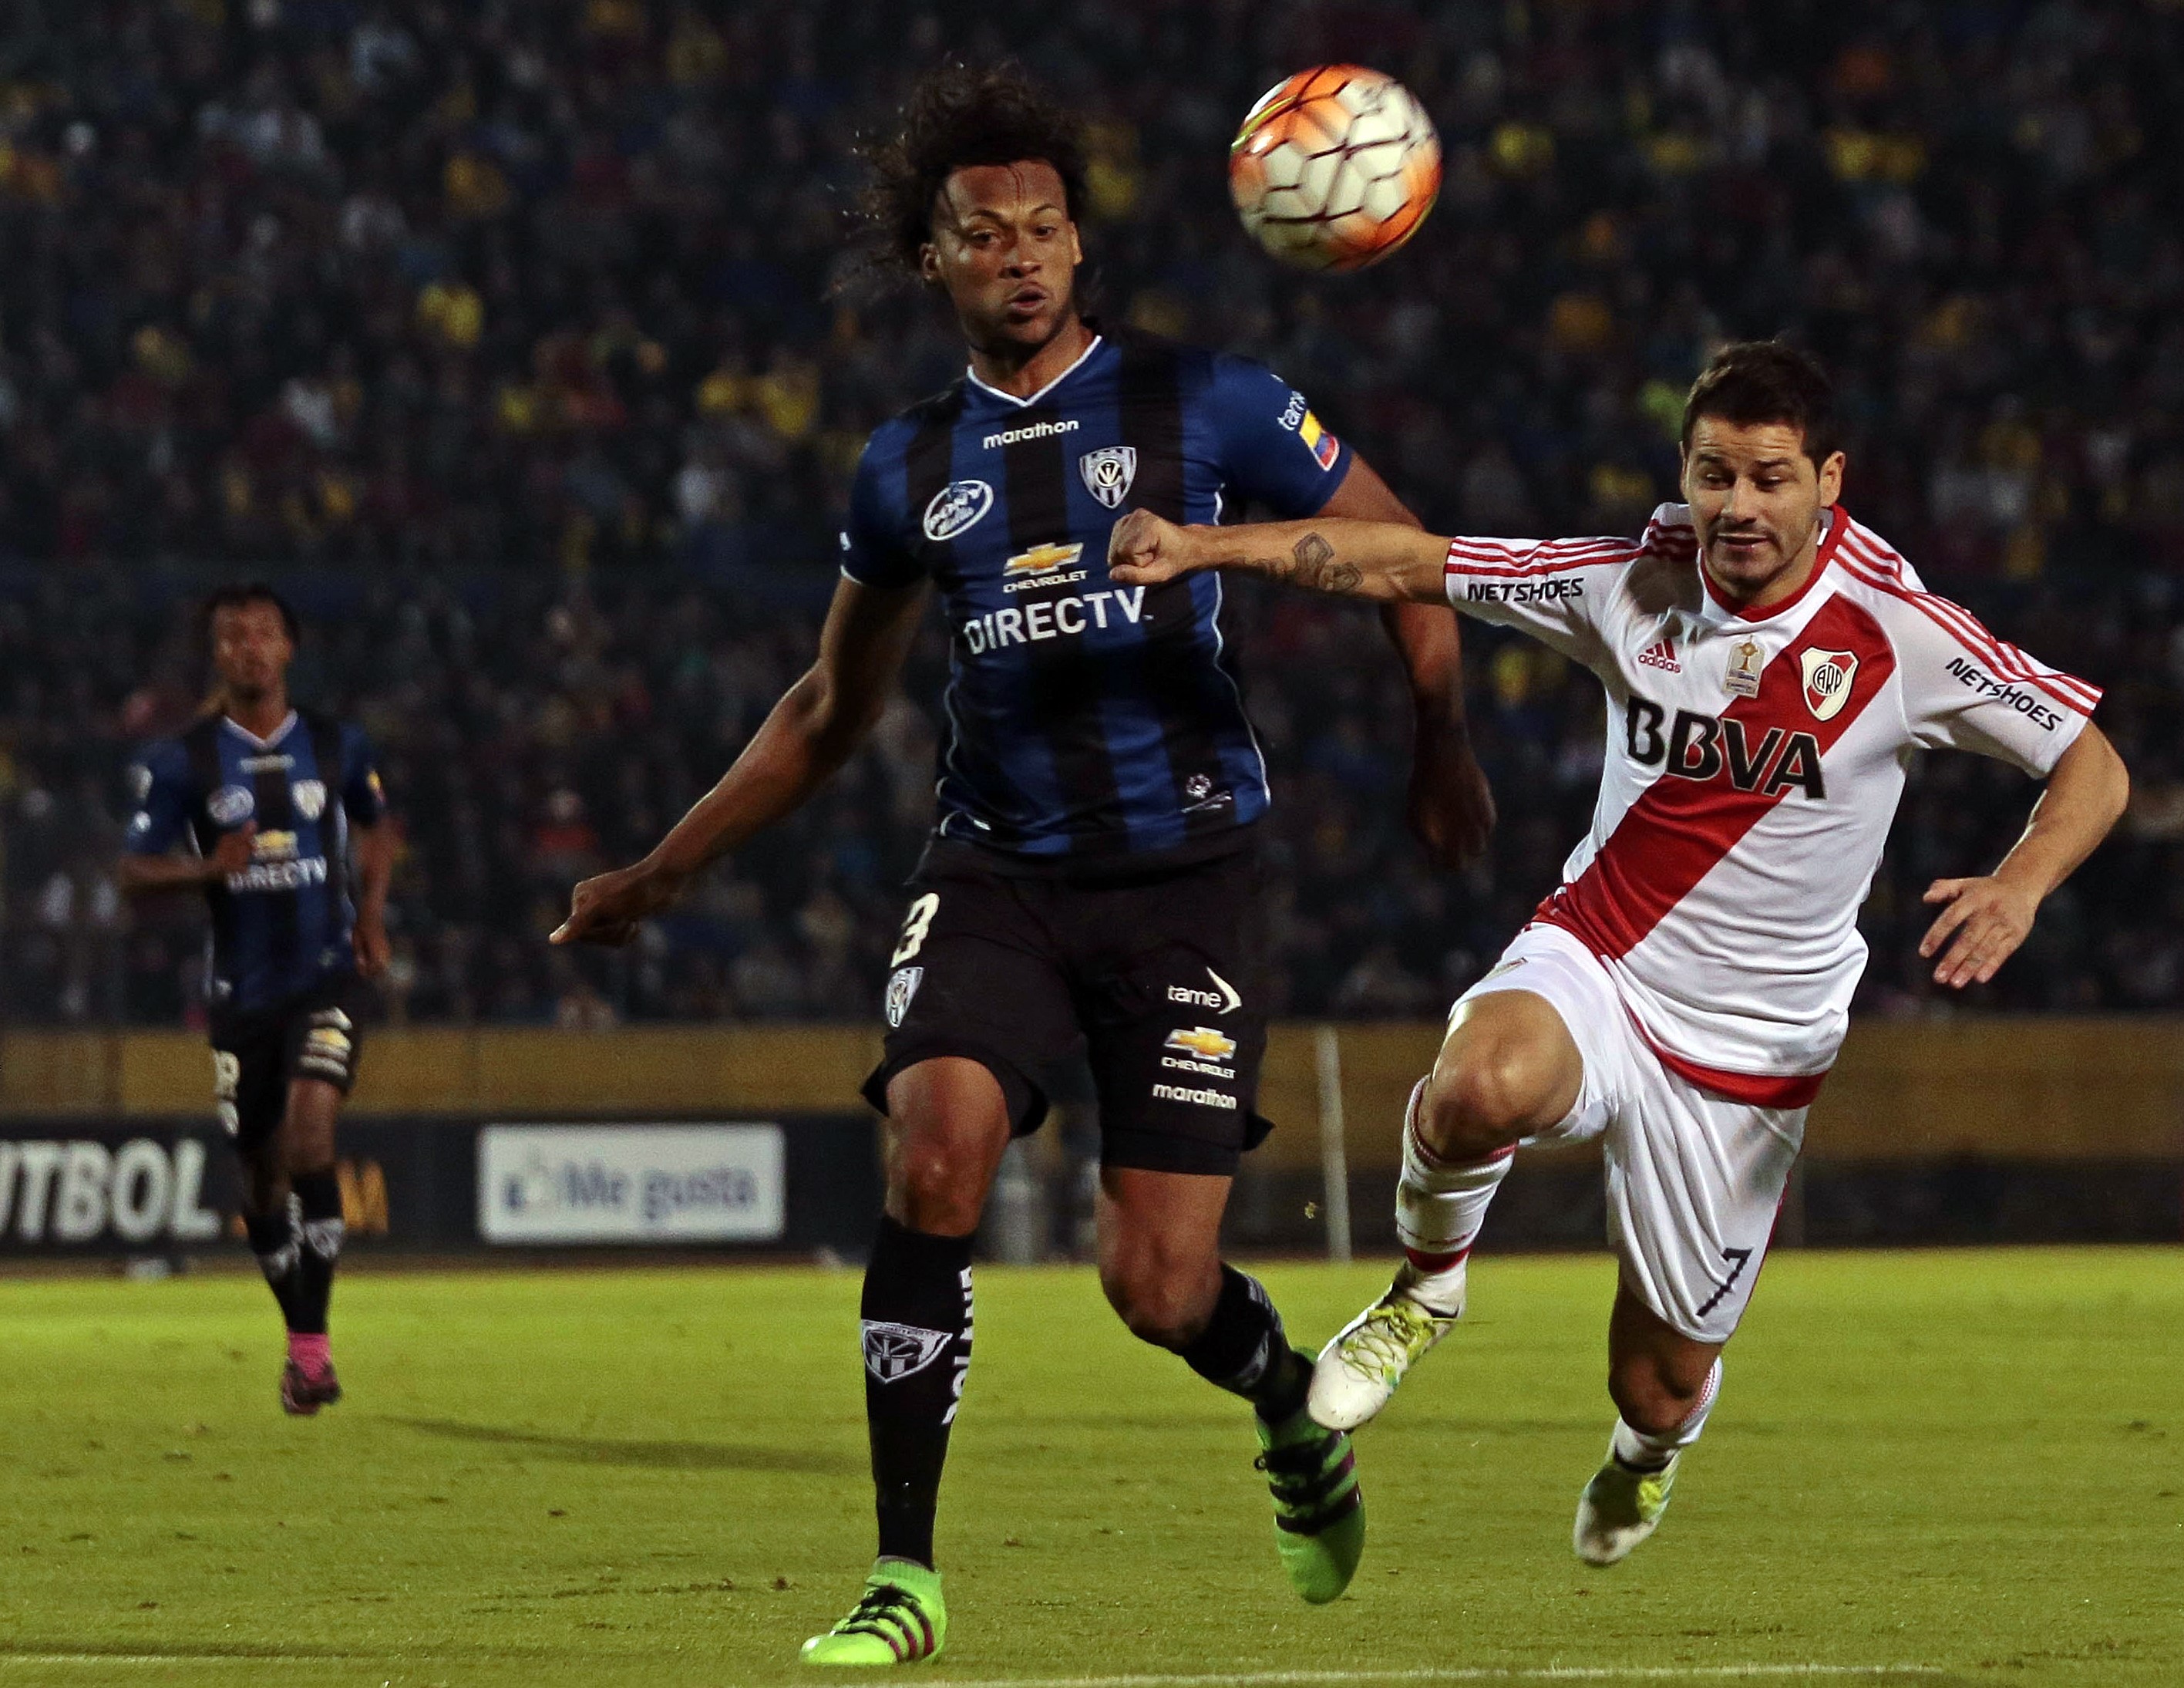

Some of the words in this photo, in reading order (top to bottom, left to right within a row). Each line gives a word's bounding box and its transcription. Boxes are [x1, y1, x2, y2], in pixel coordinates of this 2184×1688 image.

[983, 420, 1079, 450] marathon
[1003, 570, 1088, 593] CHEVROLET
[1468, 578, 1584, 601] NETSHOES
[964, 586, 1146, 655] DIRECTV
[1638, 654, 1681, 673] adidas
[1945, 658, 2063, 731] NETSHOES
[1627, 696, 1826, 800] BBVA
[1167, 985, 1221, 1008] tame
[1161, 1056, 1236, 1079] CHEVROLET
[1153, 1083, 1237, 1110] marathon
[1696, 1247, 1754, 1317] 7
